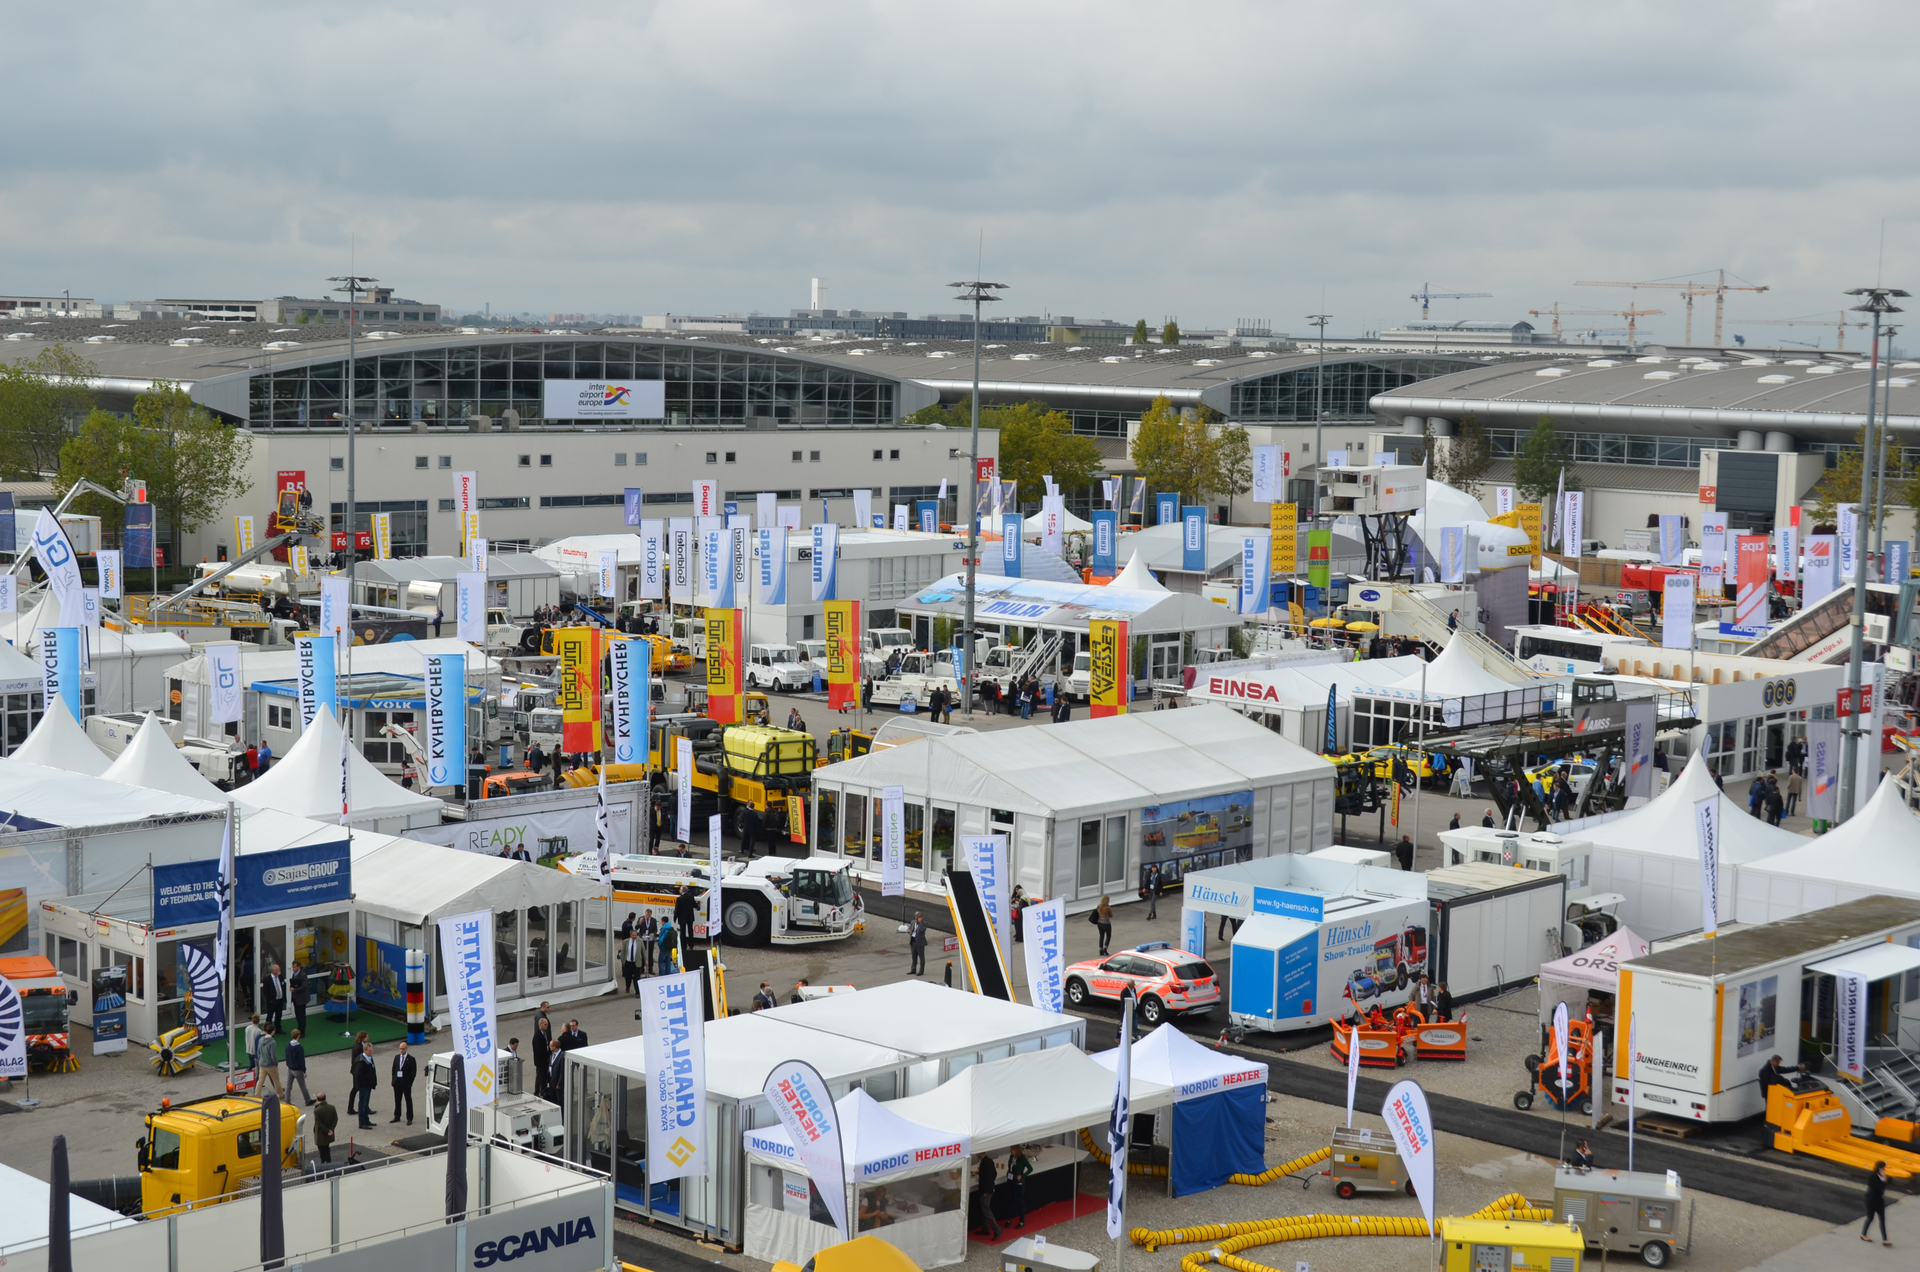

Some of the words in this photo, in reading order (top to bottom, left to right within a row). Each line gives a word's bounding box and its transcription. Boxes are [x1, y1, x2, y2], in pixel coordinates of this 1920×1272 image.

[589, 383, 606, 391] inter
[579, 391, 604, 400] airport
[982, 466, 993, 478] B5
[702, 485, 710, 516] ultihog
[1706, 490, 1715, 498] C4
[336, 537, 346, 546] F6
[360, 536, 370, 545] F5
[1510, 547, 1532, 555] DOLL
[982, 601, 1050, 618] MULAG
[1808, 638, 1843, 660] www.tips.si
[1210, 678, 1280, 702] EINSA
[1766, 680, 1794, 706] TCR
[1841, 698, 1850, 711] F6
[1862, 696, 1871, 710] F5
[1588, 716, 1610, 732] AMSS
[469, 826, 527, 849] READY
[278, 866, 308, 882] Sajas
[309, 861, 339, 878] GROUP
[160, 884, 192, 896] WELCOME
[192, 883, 201, 892] TO
[202, 882, 214, 890] THE
[287, 882, 338, 894] www.sajas-group.com
[1192, 884, 1239, 905] Hänsch
[160, 898, 169, 906] OF
[170, 893, 204, 904] TECHNICAL
[648, 896, 673, 904] Lufthansa
[1256, 898, 1320, 914] www.fg-haensch.de
[694, 924, 706, 934] 08
[1326, 920, 1371, 946] Hänsch
[1636, 1052, 1698, 1073] JUNGHEINRICH
[1182, 1078, 1218, 1096] NORDIC
[1223, 1070, 1260, 1086] HEATER
[752, 1138, 794, 1158] NORDIC
[864, 1154, 909, 1176] NORDIC
[915, 1143, 962, 1162] HEATER
[474, 1216, 596, 1268] SCANIA
